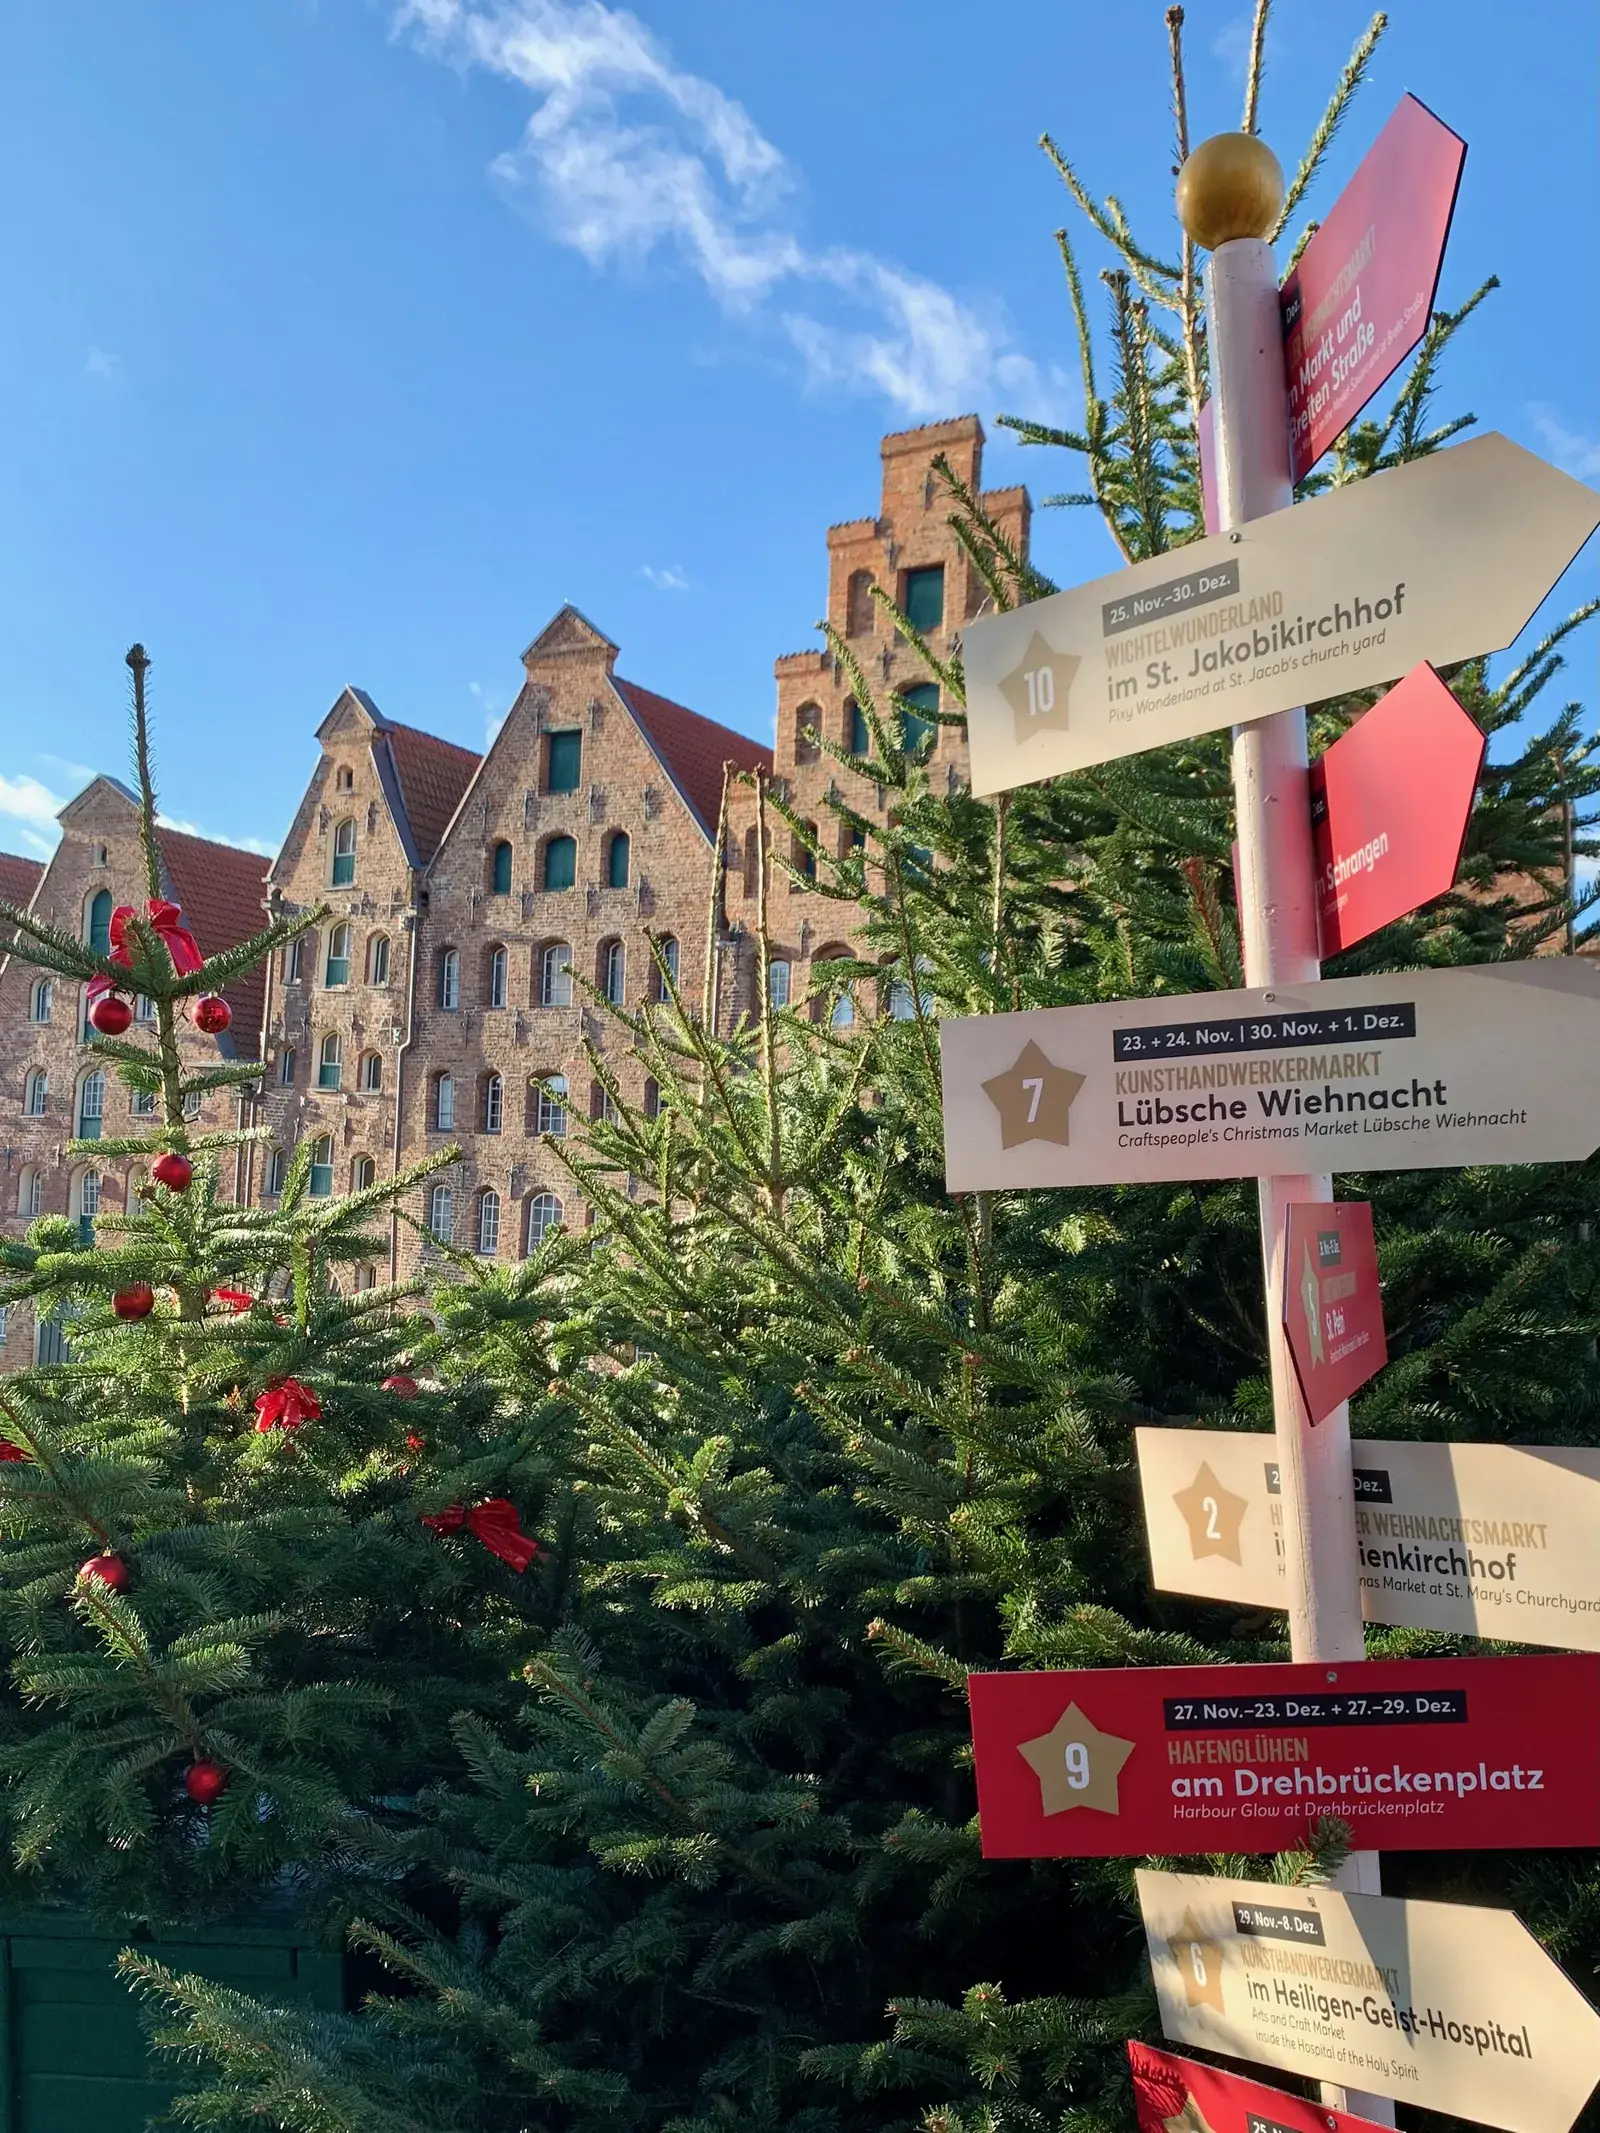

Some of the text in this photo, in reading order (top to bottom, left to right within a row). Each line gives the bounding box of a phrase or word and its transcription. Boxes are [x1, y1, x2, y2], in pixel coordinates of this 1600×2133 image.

[1286, 300, 1301, 324] Dez.
[1299, 328, 1335, 395] Markt
[1337, 284, 1362, 344] und
[1332, 322, 1375, 391] Straße
[1110, 608, 1131, 625] 25.
[1198, 573, 1232, 595] Dez.
[1104, 590, 1284, 670] WICHTELWUNDERLAND
[1107, 582, 1406, 702] im St. Jakobikirchhof
[1024, 665, 1055, 716] 10
[1108, 627, 1387, 724] Pixy Wonderland at St. Jacob's church yard
[1326, 832, 1389, 890] Schrangen
[1122, 1036, 1146, 1052] 23.
[1151, 1036, 1162, 1048] +
[1166, 1031, 1190, 1048] 24.
[1196, 1029, 1235, 1046] Nov.
[1250, 1023, 1277, 1040] 30.
[1282, 1020, 1323, 1038] Nov.
[1328, 1020, 1340, 1032] +
[1344, 1016, 1358, 1032] 1.
[1364, 1013, 1405, 1031] Dez.
[1115, 1050, 1382, 1095] KUNSTHANDWERKERMARKT
[1022, 1077, 1044, 1123] 7
[1118, 1078, 1447, 1127] Lübsche Wiehnacht
[1118, 1108, 1528, 1148] Craftspeople's Christmas Market Lübsche Wiehnacht
[1202, 1496, 1222, 1540] 2
[1372, 1511, 1548, 1550] WEIHNACHTSMARKT
[1359, 1540, 1517, 1582] ienkirchhof
[1383, 1576, 1426, 1594] Market
[1429, 1582, 1443, 1596] at
[1446, 1582, 1463, 1599] St.
[1467, 1586, 1513, 1608] Mary's
[1516, 1589, 1600, 1614] Churchyard
[1174, 1704, 1198, 1720] 27.
[1286, 1701, 1326, 1717] Dez.
[1331, 1704, 1342, 1715] +
[1416, 1698, 1457, 1714] Dez.
[1064, 1742, 1091, 1790] 9
[1167, 1734, 1309, 1765] HAFENGLÜHEN
[1171, 1762, 1545, 1799] am Drehbrückenplatz
[1173, 1798, 1445, 1819] Harbour Glow at Drehbrückenplatz
[1238, 1909, 1254, 1926] 29.
[1294, 1916, 1319, 1935] Dez.
[1189, 1941, 1207, 1988] 6
[1239, 1943, 1401, 1994] KUNSTHANDWERKERMARKT
[1246, 1972, 1533, 2060] im Heiligen-Geist-Hospital
[1252, 2007, 1346, 2041] Arts and Craft Market
[1255, 2030, 1420, 2082] inside the Hospital of the Holy Spirit
